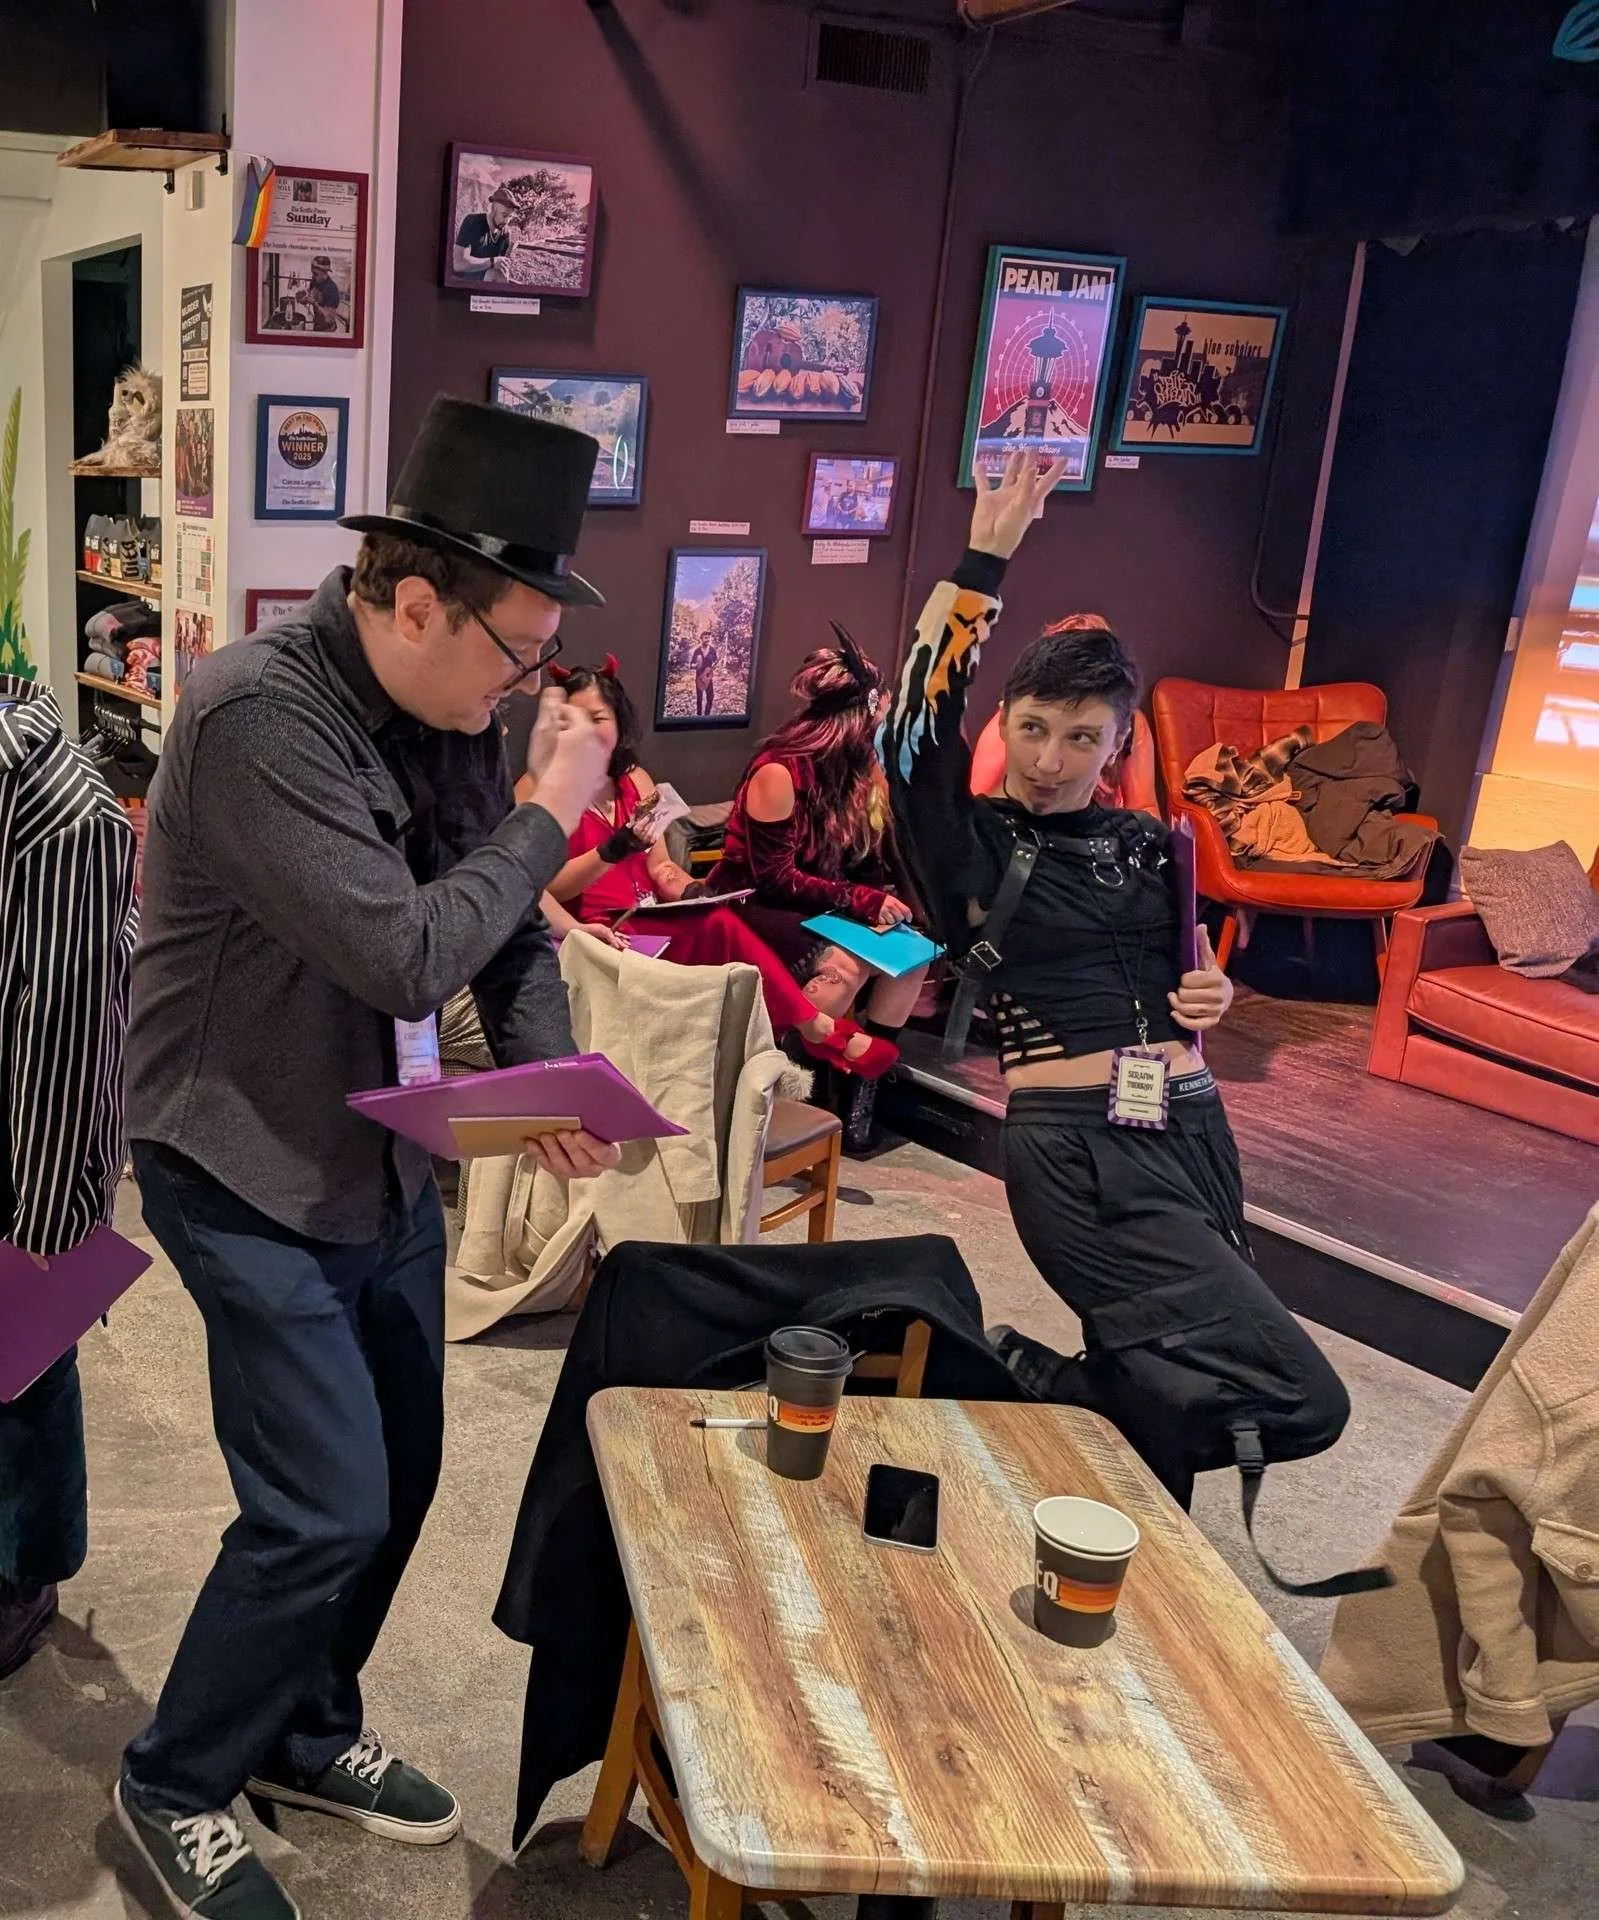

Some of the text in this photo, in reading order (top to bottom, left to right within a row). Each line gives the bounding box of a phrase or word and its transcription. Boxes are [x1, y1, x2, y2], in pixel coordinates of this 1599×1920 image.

[286, 212, 331, 228] Sunday
[1003, 267, 1107, 300] PEARL JAM
[281, 440, 324, 453] WINNER
